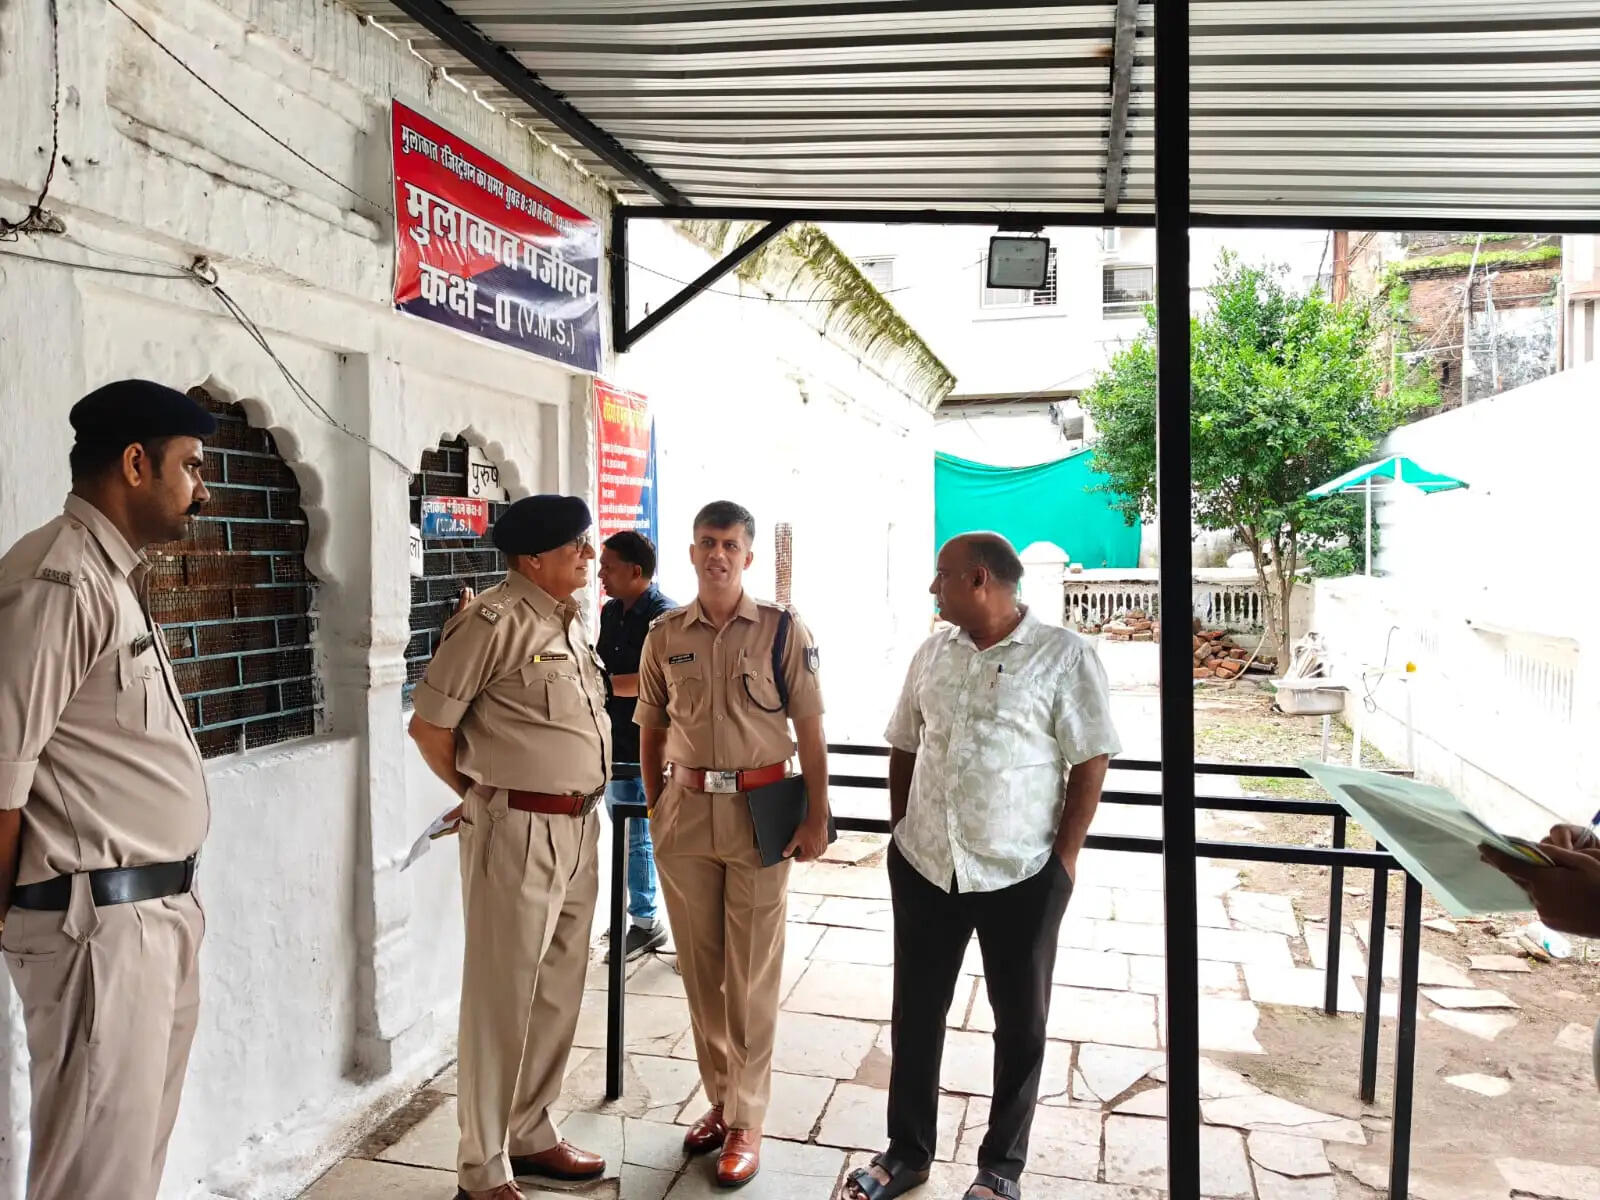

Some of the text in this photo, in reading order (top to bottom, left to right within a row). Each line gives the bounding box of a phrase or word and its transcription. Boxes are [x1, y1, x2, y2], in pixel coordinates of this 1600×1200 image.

[401, 125, 439, 162] मुलाकात
[475, 168, 487, 190] का
[487, 174, 505, 200] समय
[505, 184, 520, 210] सुबह
[520, 193, 537, 218] 8:30
[405, 182, 520, 271] मुलाकात
[518, 304, 576, 355] (V.M.S.)
